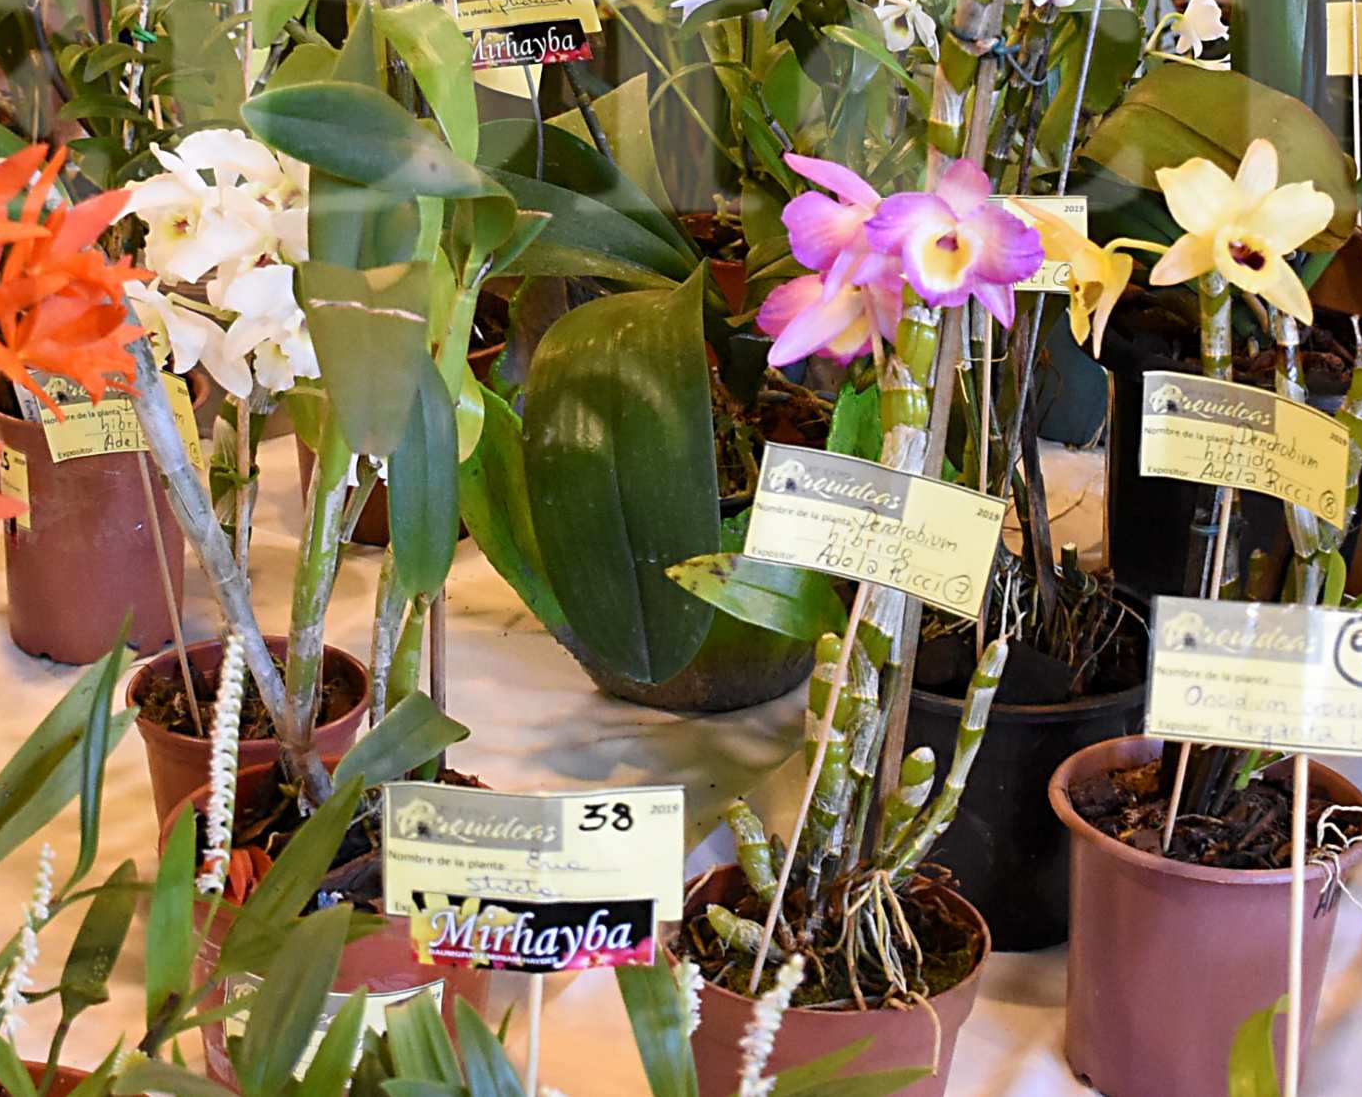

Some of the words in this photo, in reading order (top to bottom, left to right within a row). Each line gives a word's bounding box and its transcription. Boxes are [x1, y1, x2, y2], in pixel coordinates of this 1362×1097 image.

[472, 26, 577, 63] Mirhayba
[1199, 461, 1257, 485] Adela
[578, 801, 635, 832] 38
[388, 850, 434, 865] Nombre
[438, 856, 452, 867] de
[429, 909, 632, 970] Mirhayba
